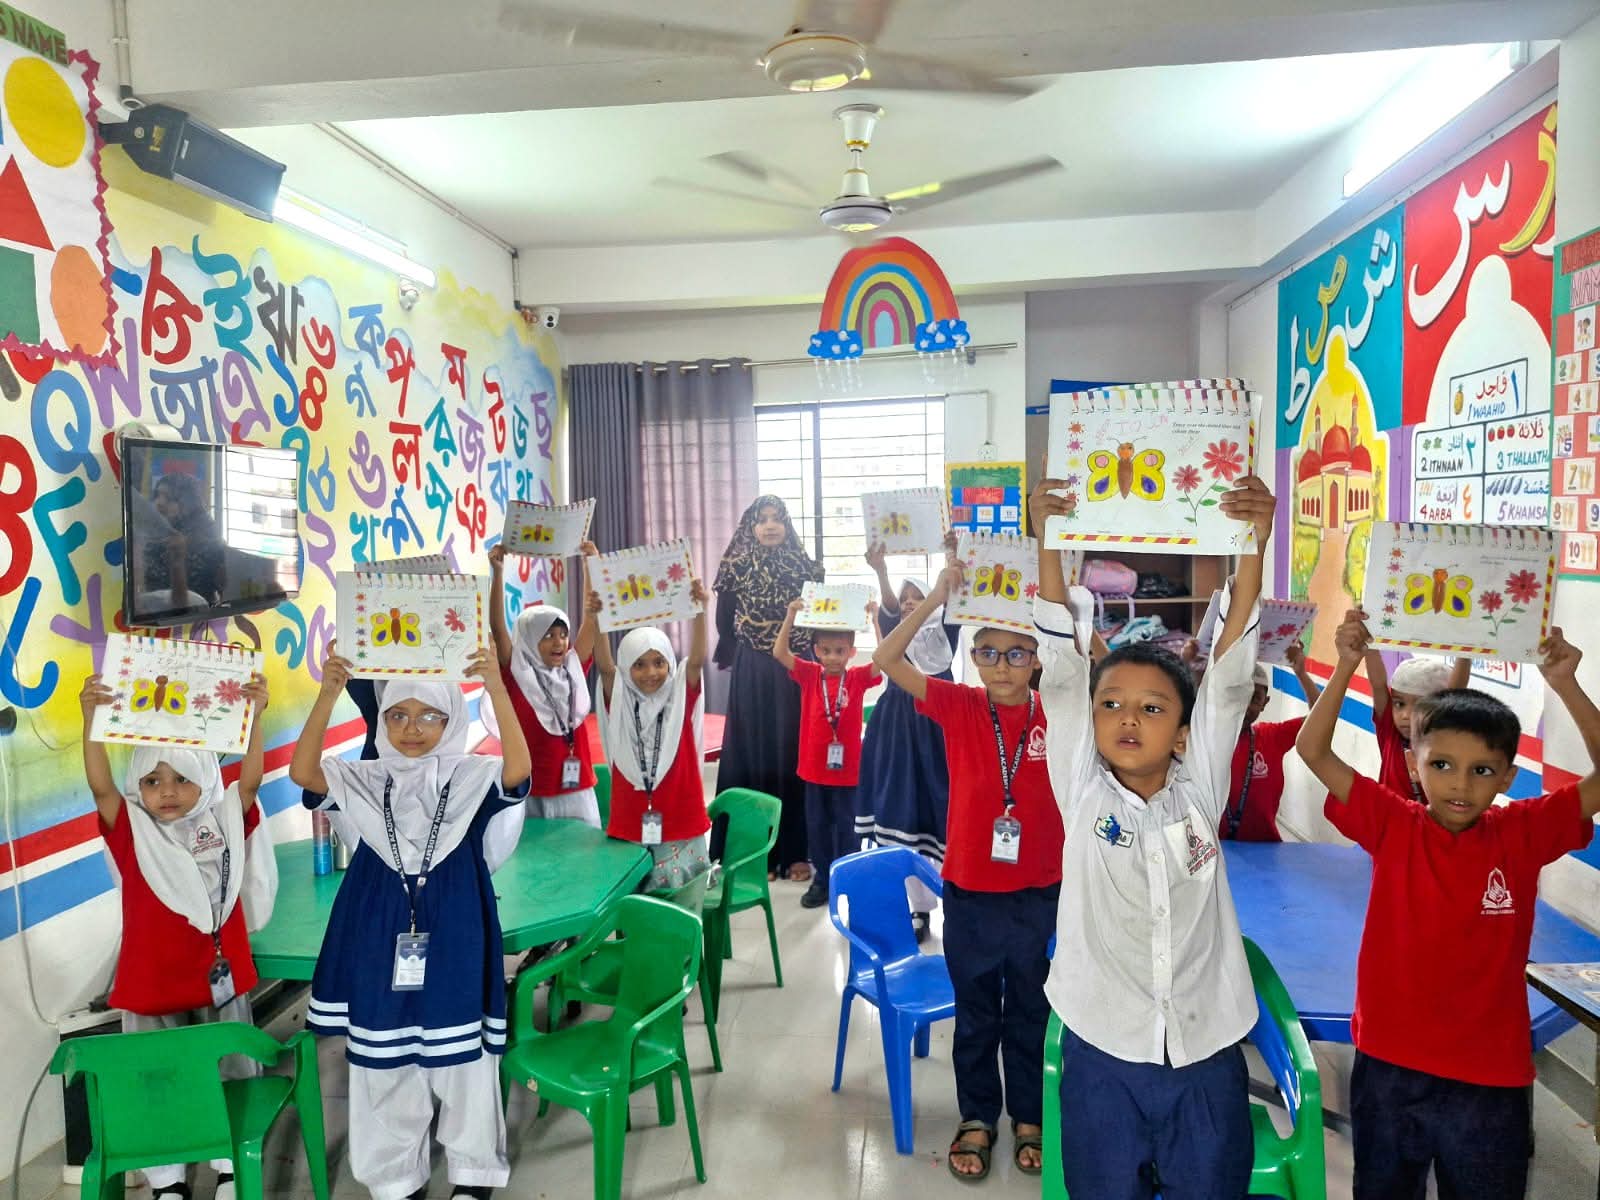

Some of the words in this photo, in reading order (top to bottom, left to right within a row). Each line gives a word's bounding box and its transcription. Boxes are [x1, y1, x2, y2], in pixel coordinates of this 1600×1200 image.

[12, 12, 68, 66] NAME
[1408, 159, 1512, 328] س
[1570, 267, 1600, 309] NAM
[348, 303, 386, 370] ক
[30, 369, 101, 482] Q
[1473, 401, 1506, 419] WAAHID
[389, 420, 422, 491] ল
[1497, 451, 1504, 470] 3
[1564, 438, 1572, 452] 5
[1421, 458, 1428, 472] 2
[1429, 458, 1463, 473] ITHNAAN
[1420, 504, 1428, 519] 4
[1429, 507, 1452, 521] ARBA
[1497, 501, 1507, 520] 5
[1507, 500, 1547, 521] KHAMSA
[32, 476, 88, 606] F
[1569, 541, 1581, 558] 10
[0, 576, 59, 709] J
[425, 824, 439, 862] ACADEMY
